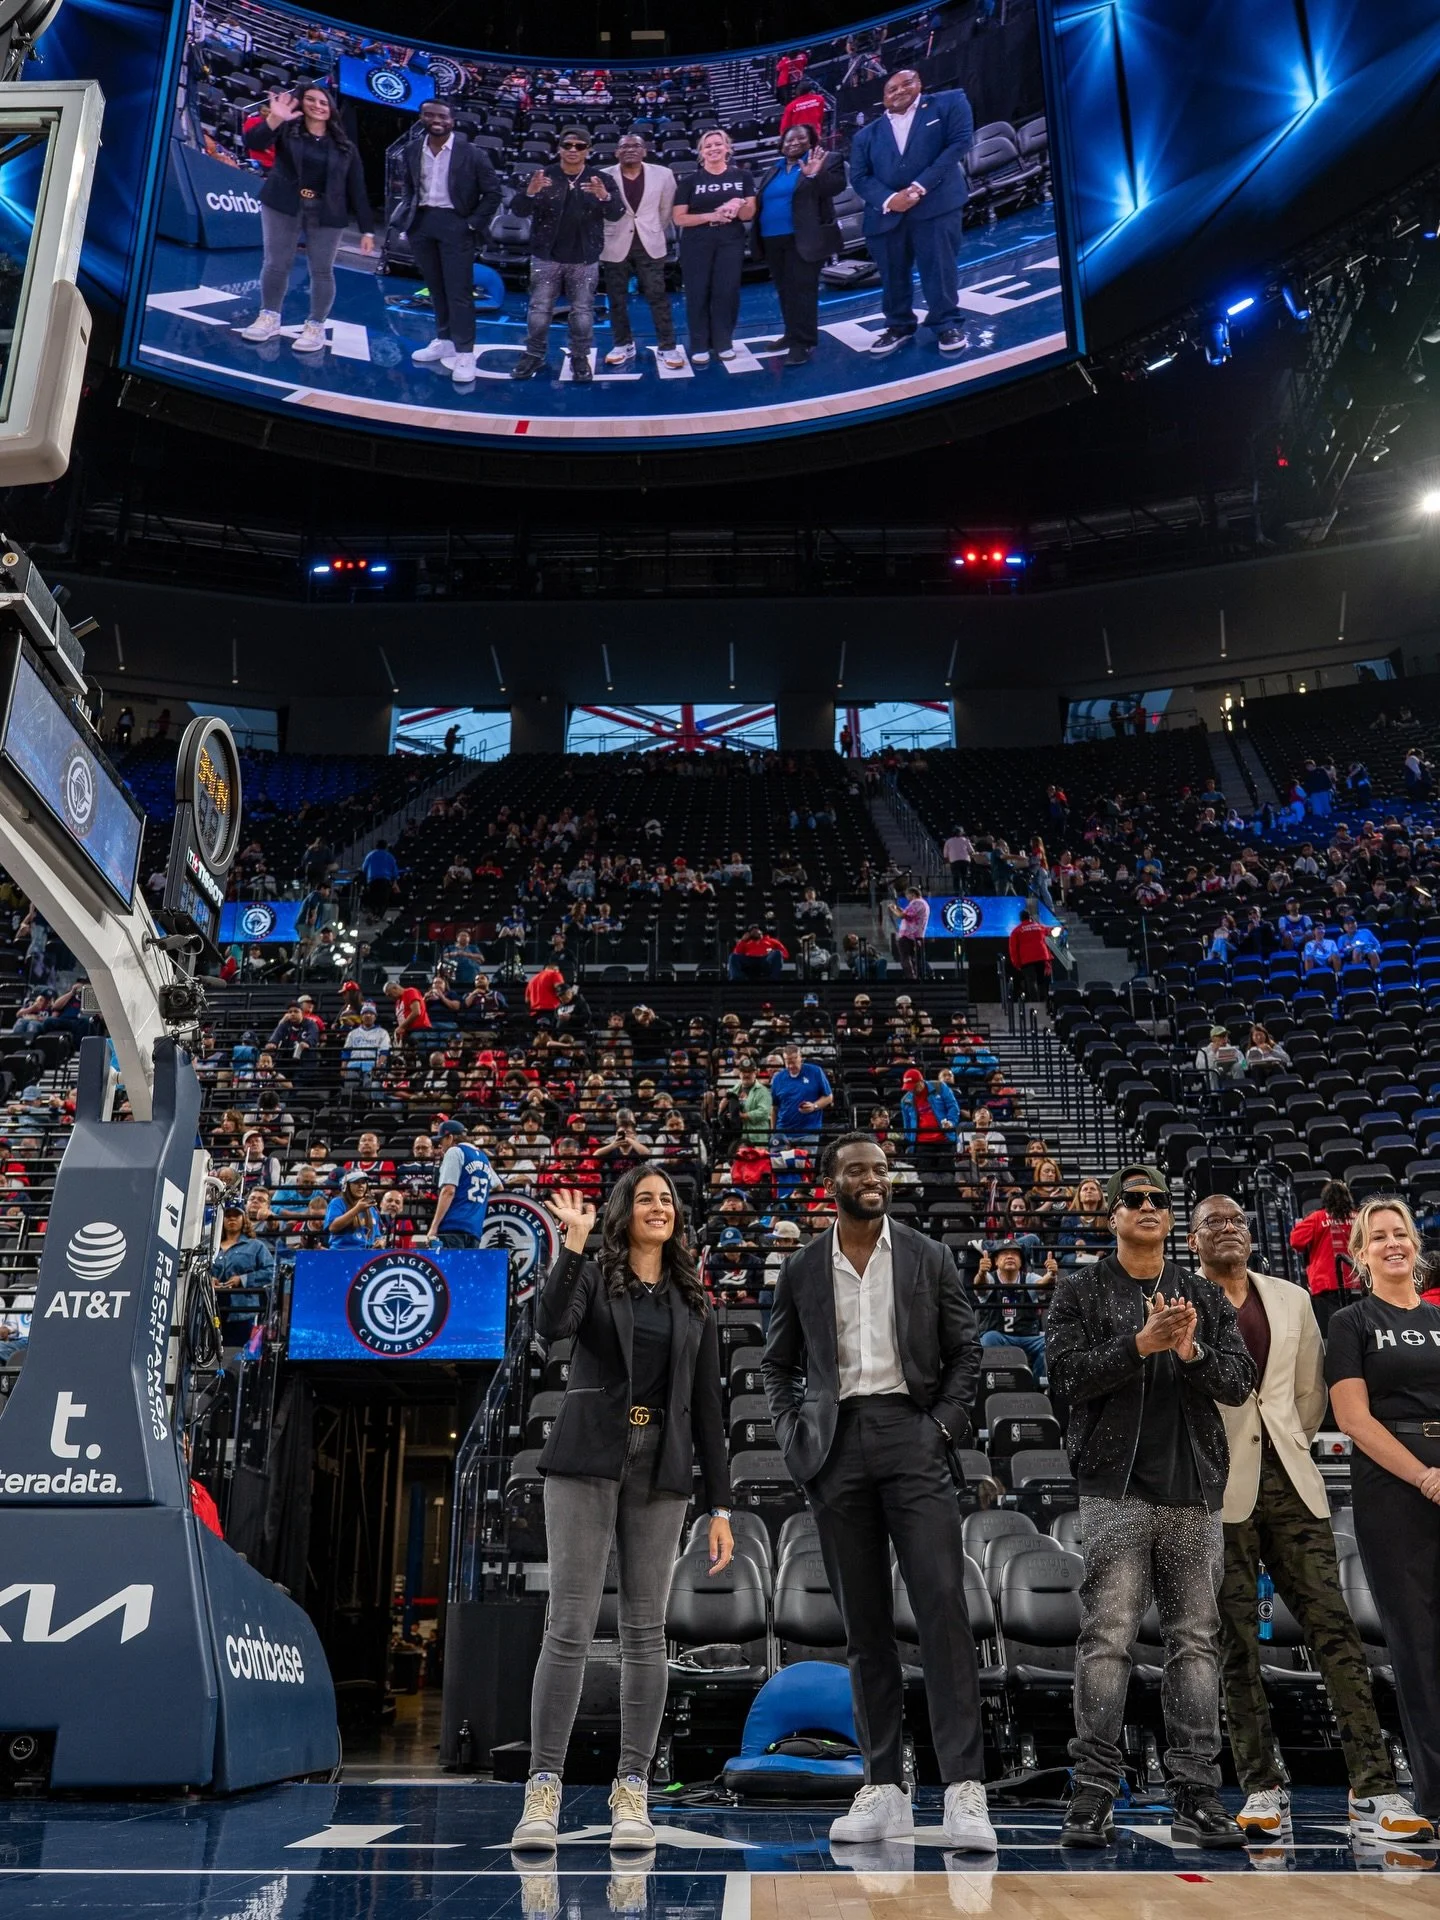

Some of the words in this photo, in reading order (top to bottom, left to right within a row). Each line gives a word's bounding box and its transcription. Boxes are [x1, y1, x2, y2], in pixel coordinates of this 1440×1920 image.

[695, 182, 743, 195] HOPE
[198, 861, 224, 907] TISSOT
[467, 1175, 488, 1204] 23
[487, 1204, 546, 1237] ANGELES
[355, 1265, 377, 1291] LOS
[386, 1256, 445, 1293] ANGELES
[44, 1290, 131, 1319] AT&T
[149, 1250, 164, 1341] RESORT
[358, 1328, 433, 1353] CLIPPERS
[1004, 1316, 1014, 1333] 2
[154, 1255, 173, 1441] PECHANGA
[147, 1353, 160, 1441] CASINO
[225, 1623, 305, 1685] coinbase
